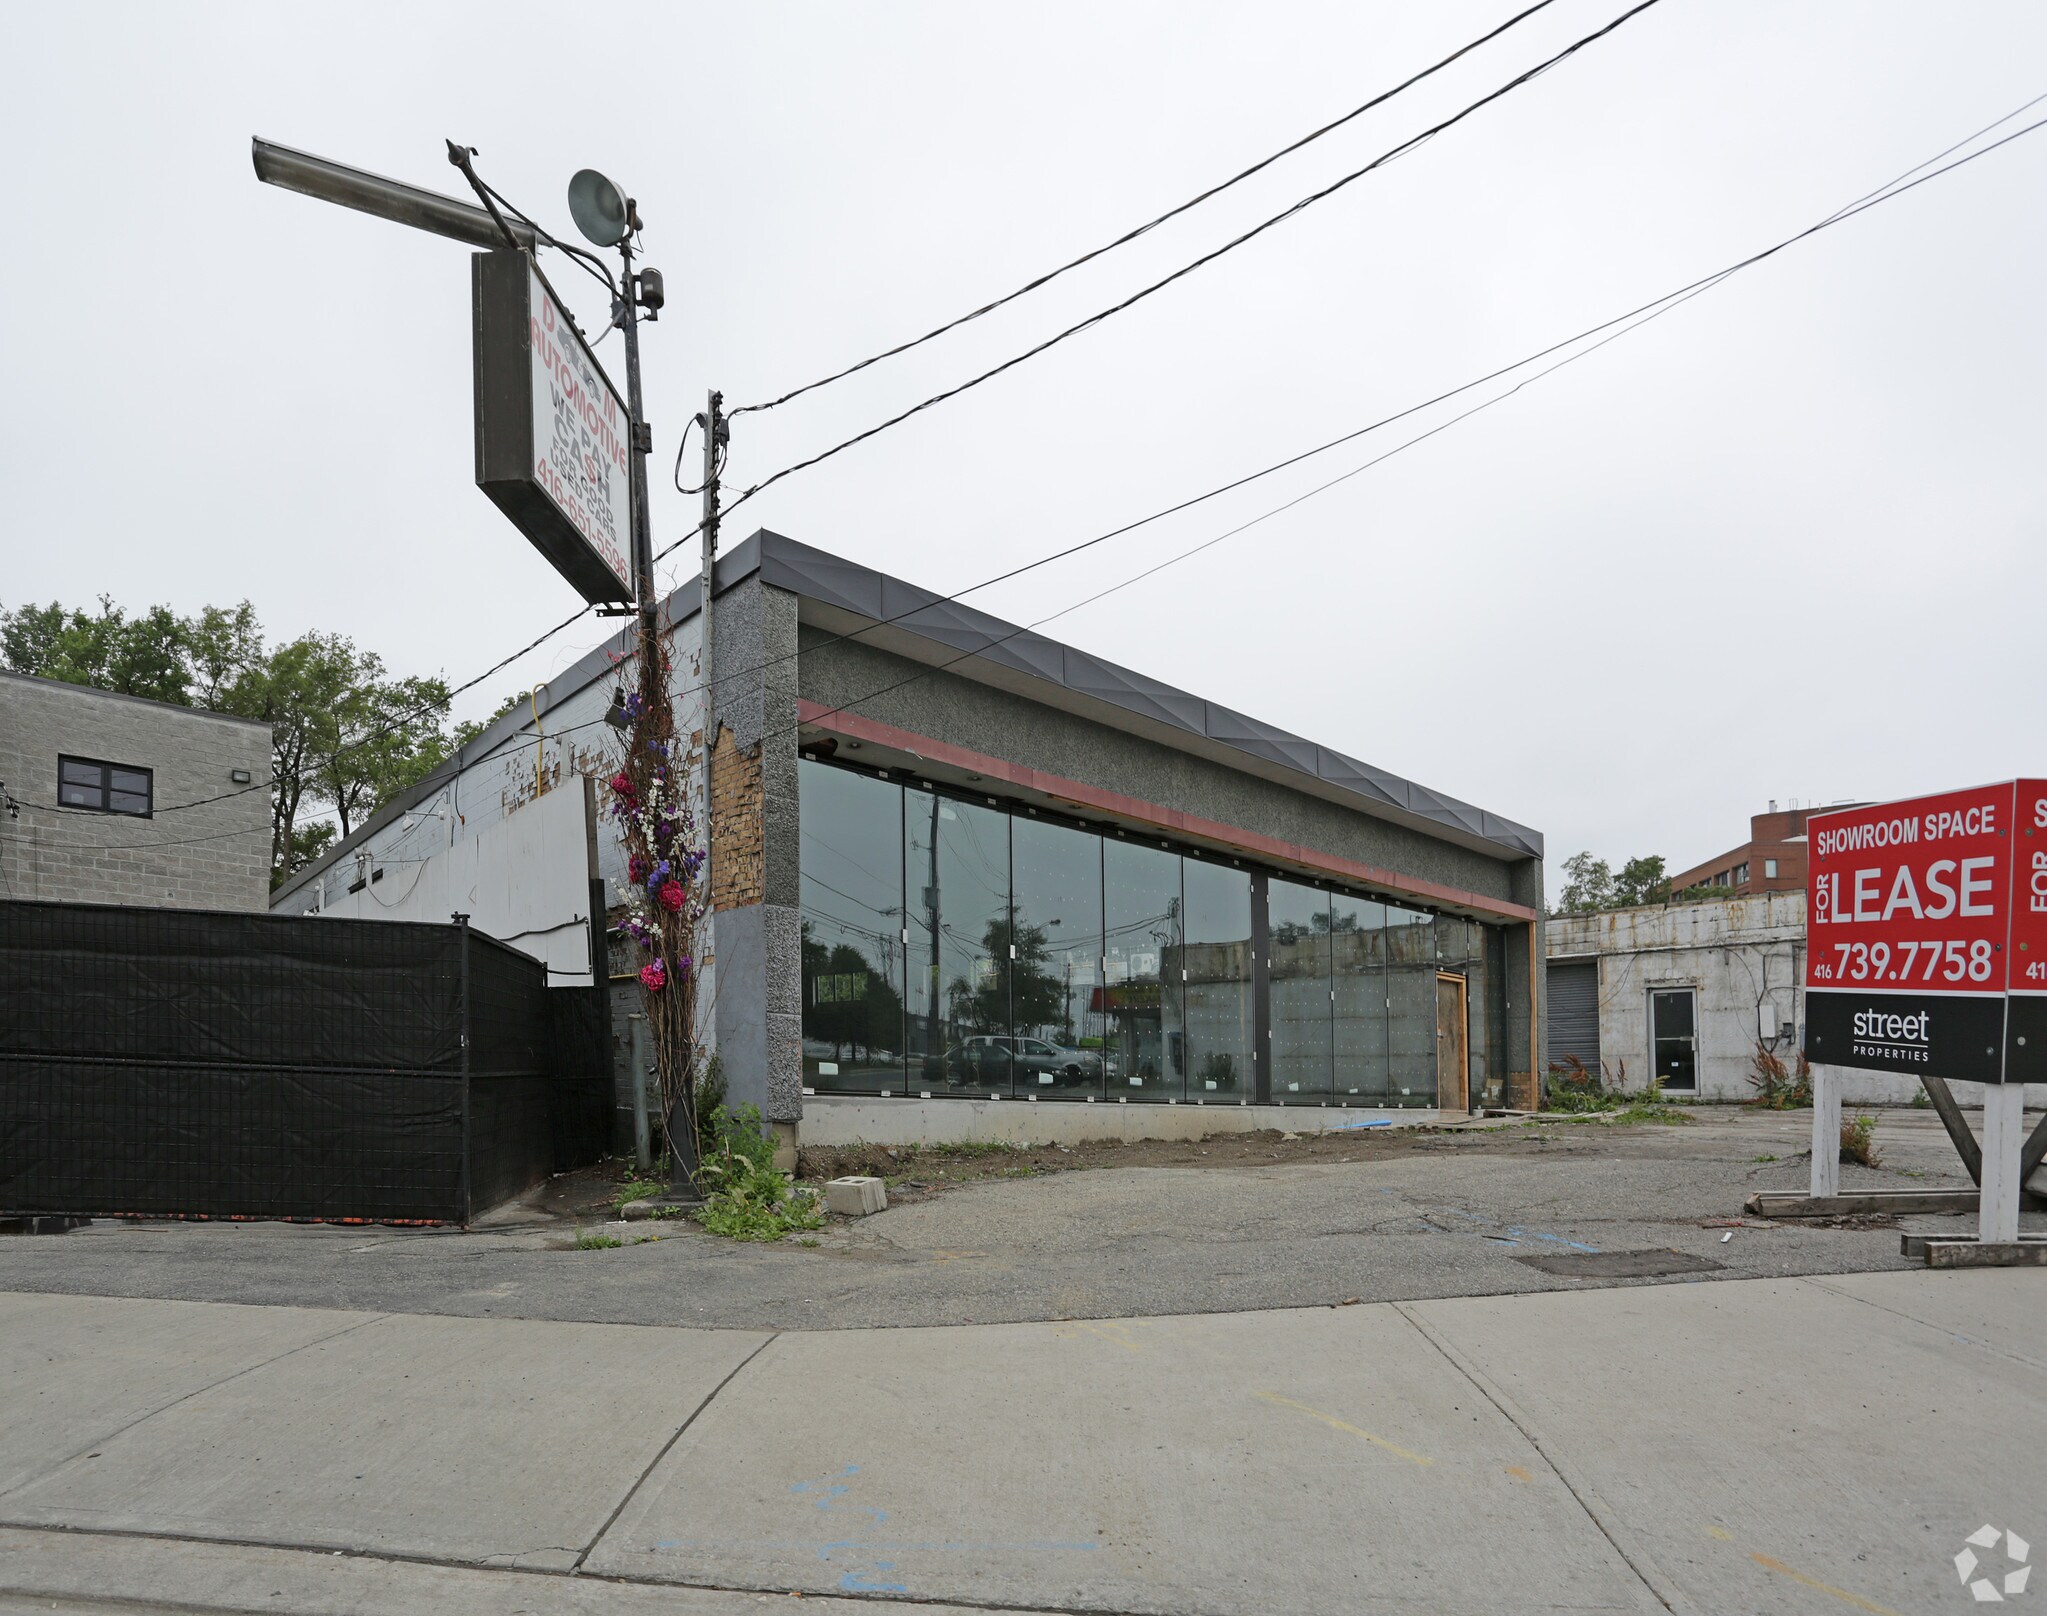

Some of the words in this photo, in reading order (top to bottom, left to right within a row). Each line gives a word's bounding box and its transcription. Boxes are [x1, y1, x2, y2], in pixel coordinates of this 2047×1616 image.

[543, 294, 554, 332] D
[604, 390, 616, 430] M
[530, 317, 626, 476] AUTOMOTIVE
[550, 380, 575, 435] WE
[581, 425, 611, 478] PAY
[551, 447, 582, 500] USED
[587, 498, 616, 542] CARS
[552, 435, 576, 479] FOR
[580, 475, 613, 524] GOOD
[538, 458, 627, 582] 416-651-5596
[1817, 817, 1919, 856] SHOWROOM
[1924, 805, 1995, 841] SPACE
[1816, 873, 1829, 924] FOR
[1831, 856, 1995, 924] LEASE
[2030, 851, 2047, 912] FOR
[1814, 964, 1832, 980] 416
[1834, 939, 1992, 982] 739.7758
[2026, 962, 2047, 980] 41
[1853, 1045, 1929, 1062] PROPERTIES
[1854, 1008, 1930, 1041] street
